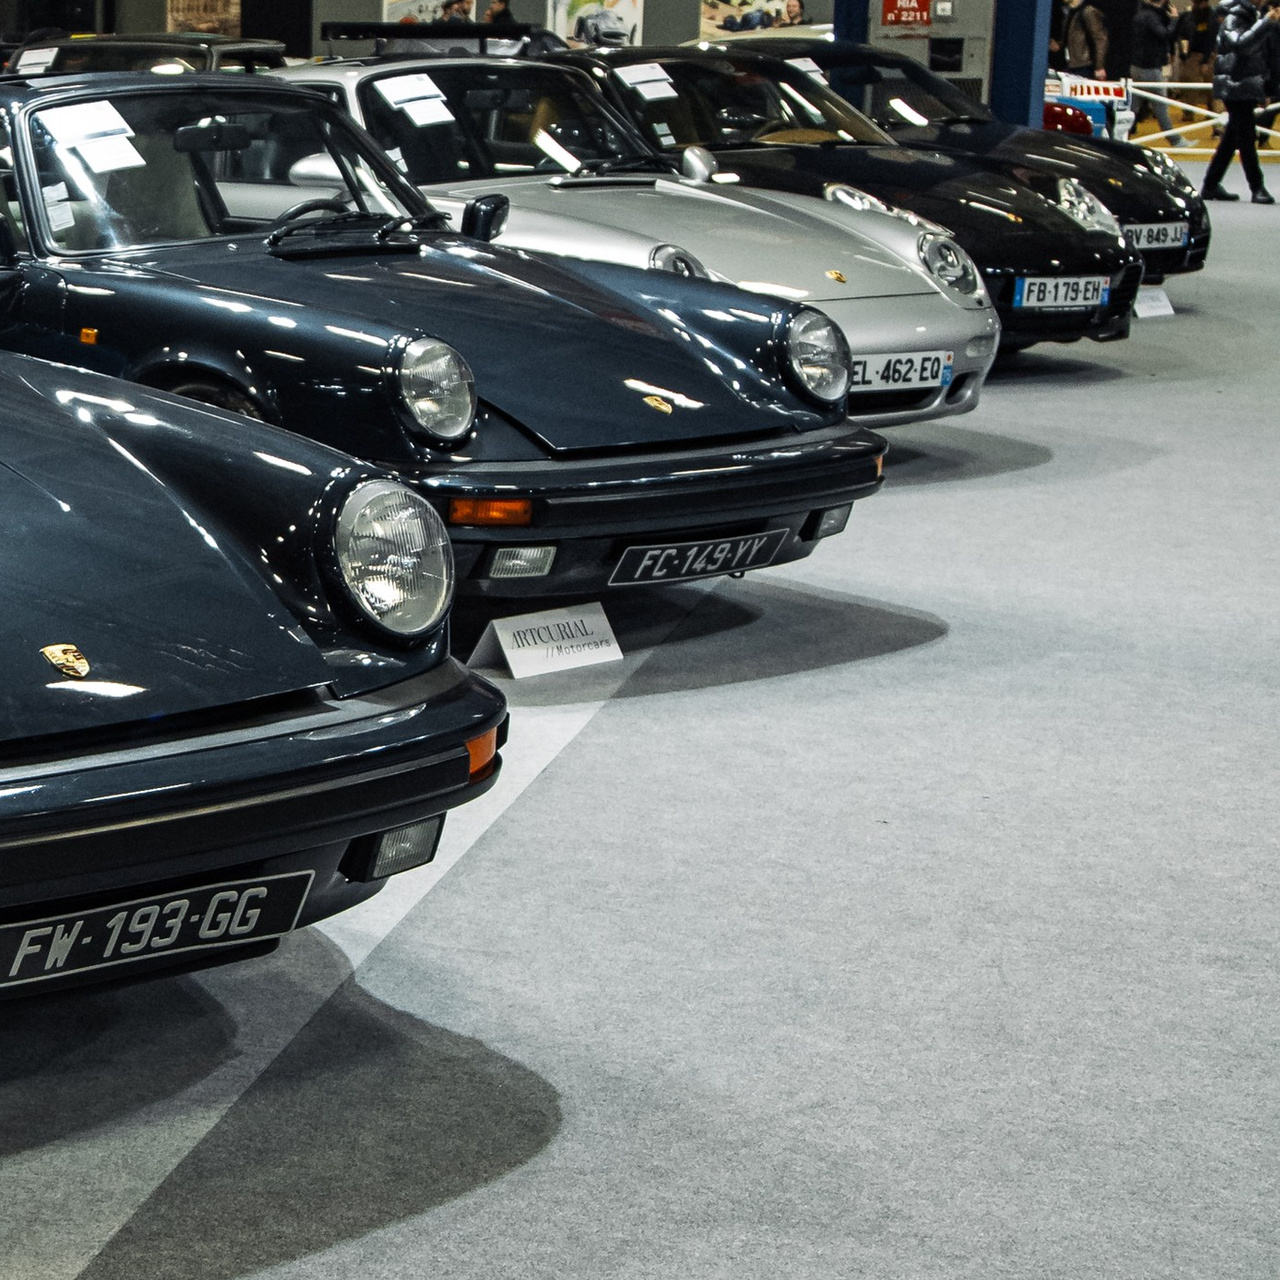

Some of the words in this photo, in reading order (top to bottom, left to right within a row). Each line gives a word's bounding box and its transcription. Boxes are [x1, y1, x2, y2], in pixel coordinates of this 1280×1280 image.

[901, 11, 928, 21] 2211
[633, 536, 768, 579] FC-149-YY
[511, 619, 594, 650] ARTCURIAL
[8, 887, 268, 977] FW-193-GG
